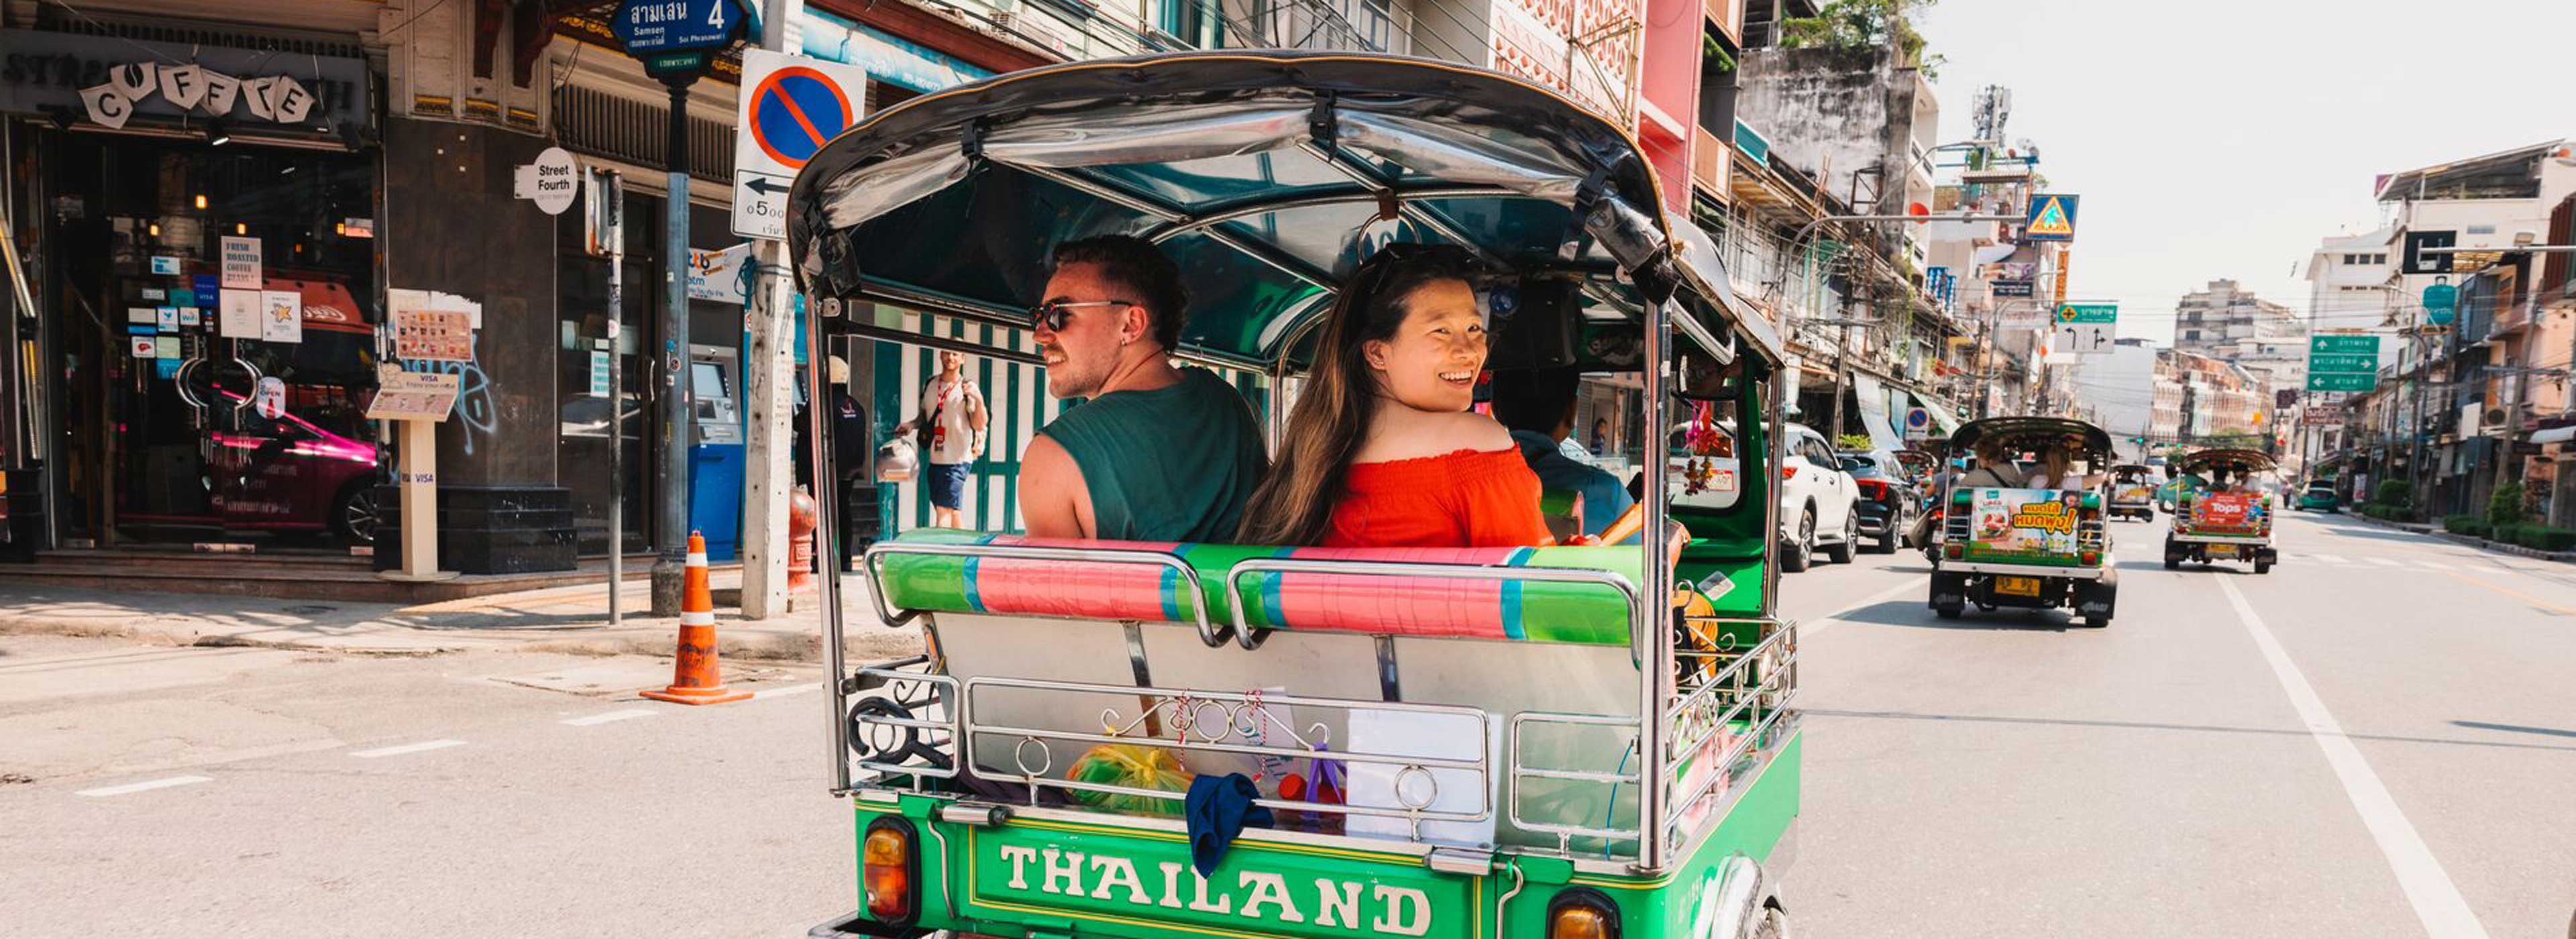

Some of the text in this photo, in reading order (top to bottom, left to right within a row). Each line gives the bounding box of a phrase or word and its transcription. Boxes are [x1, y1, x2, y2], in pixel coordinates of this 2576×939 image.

[631, 0, 724, 29] สามเสน 4
[634, 26, 665, 36] Samsen
[539, 164, 569, 176] Street
[538, 179, 570, 190] Fourth
[415, 473, 433, 483] VISA
[2211, 503, 2241, 514] Tops
[1000, 844, 1432, 937] THAILAND
